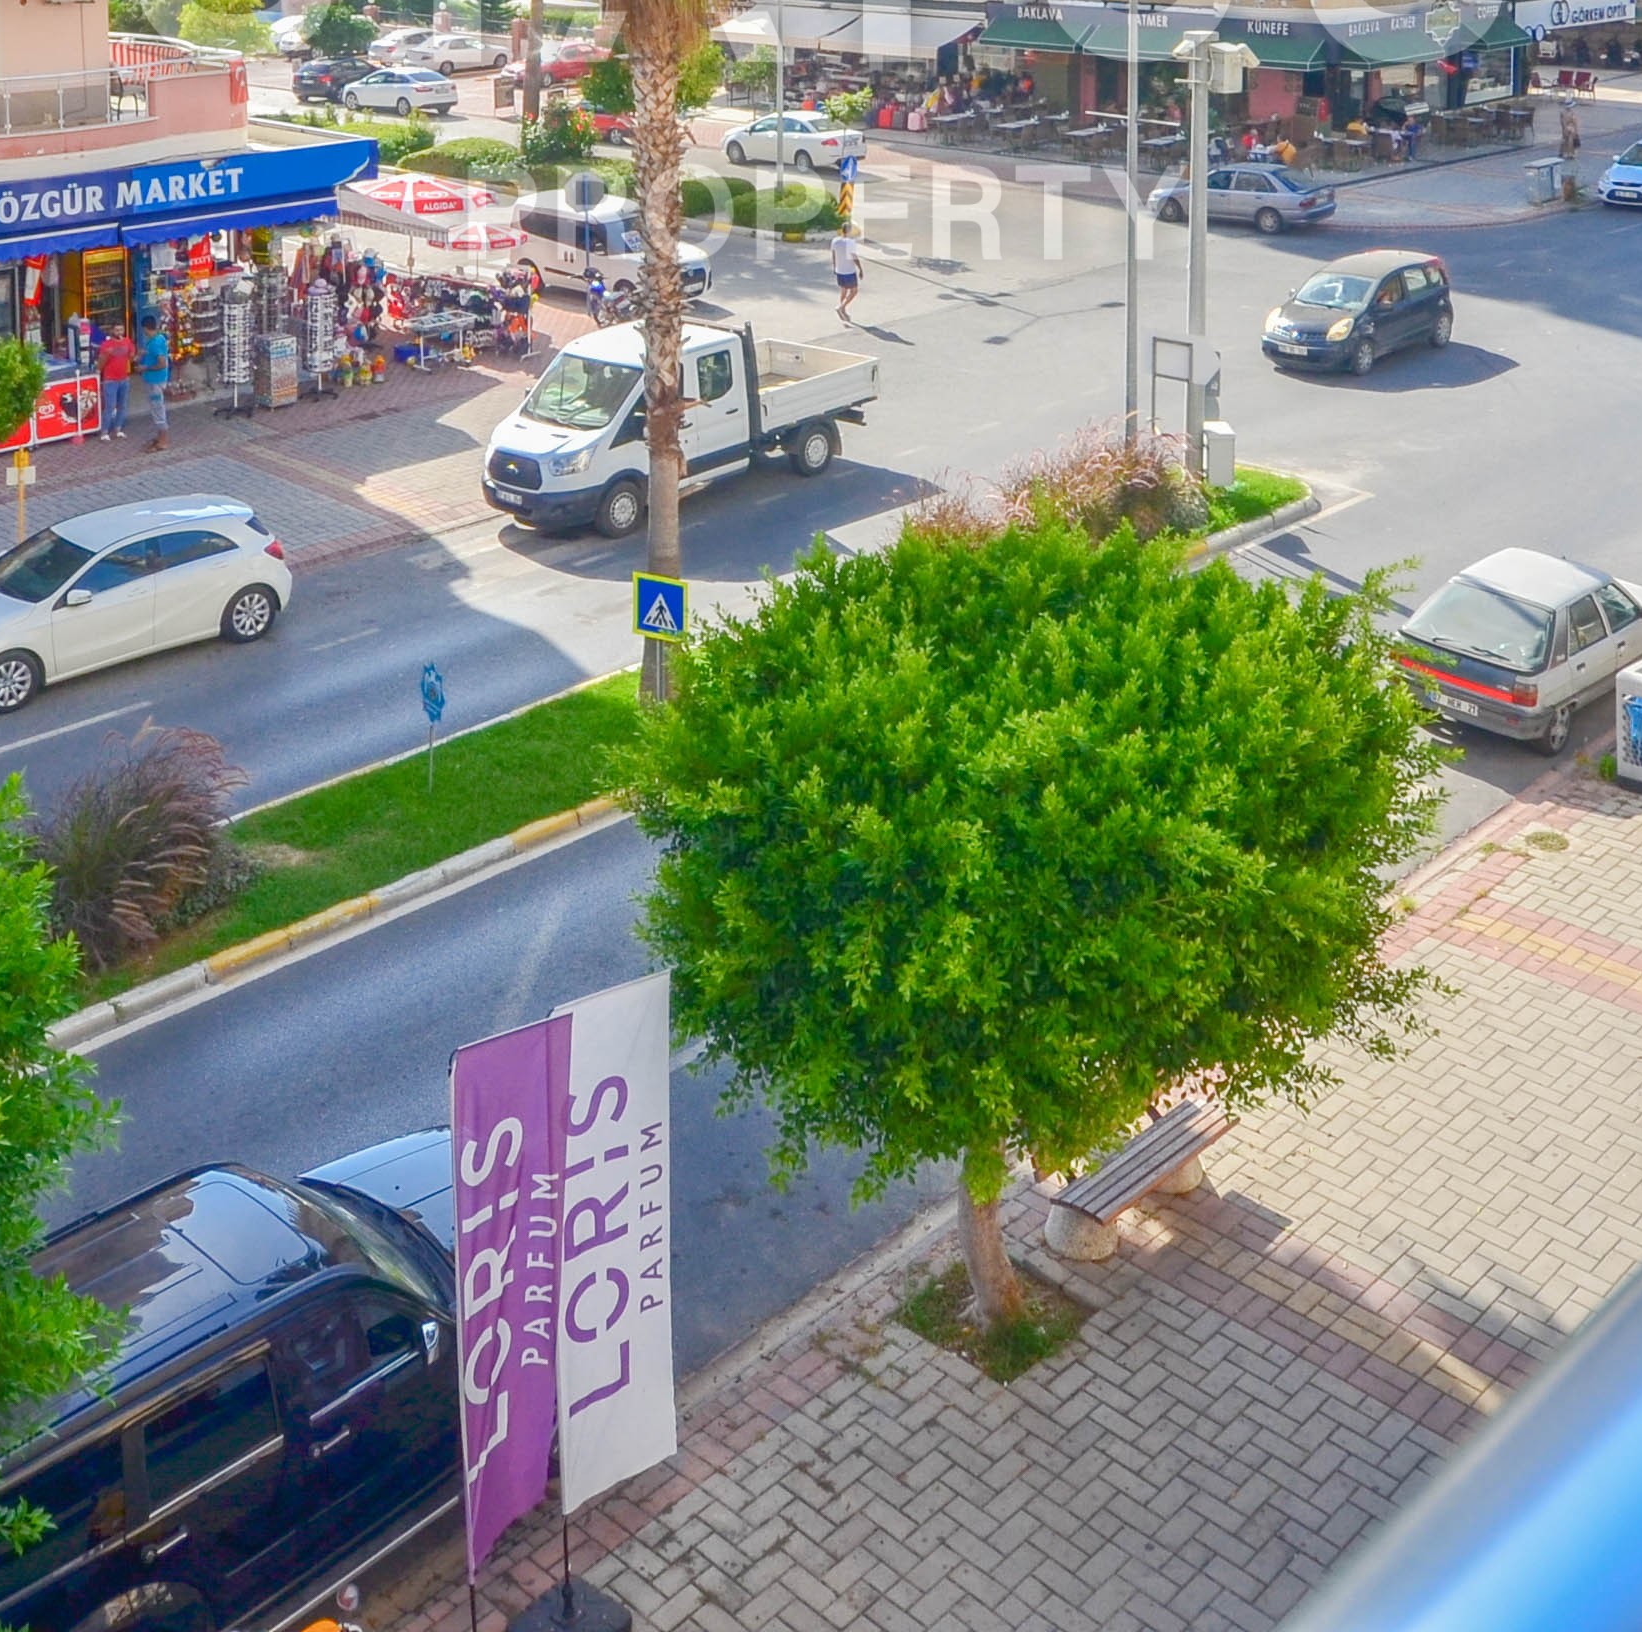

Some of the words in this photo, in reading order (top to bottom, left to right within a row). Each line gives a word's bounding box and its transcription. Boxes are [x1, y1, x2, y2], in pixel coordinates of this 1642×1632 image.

[1017, 6, 1064, 22] BAKLAVA
[1571, 6, 1605, 24] GÖRKEM
[1247, 18, 1290, 36] KÜNEFE
[1348, 20, 1380, 37] BAKLAVA
[115, 167, 244, 209] MARKET
[422, 201, 455, 212] ALGIDA
[639, 1120, 664, 1315] PARFUM
[520, 1172, 559, 1368] PARFUM
